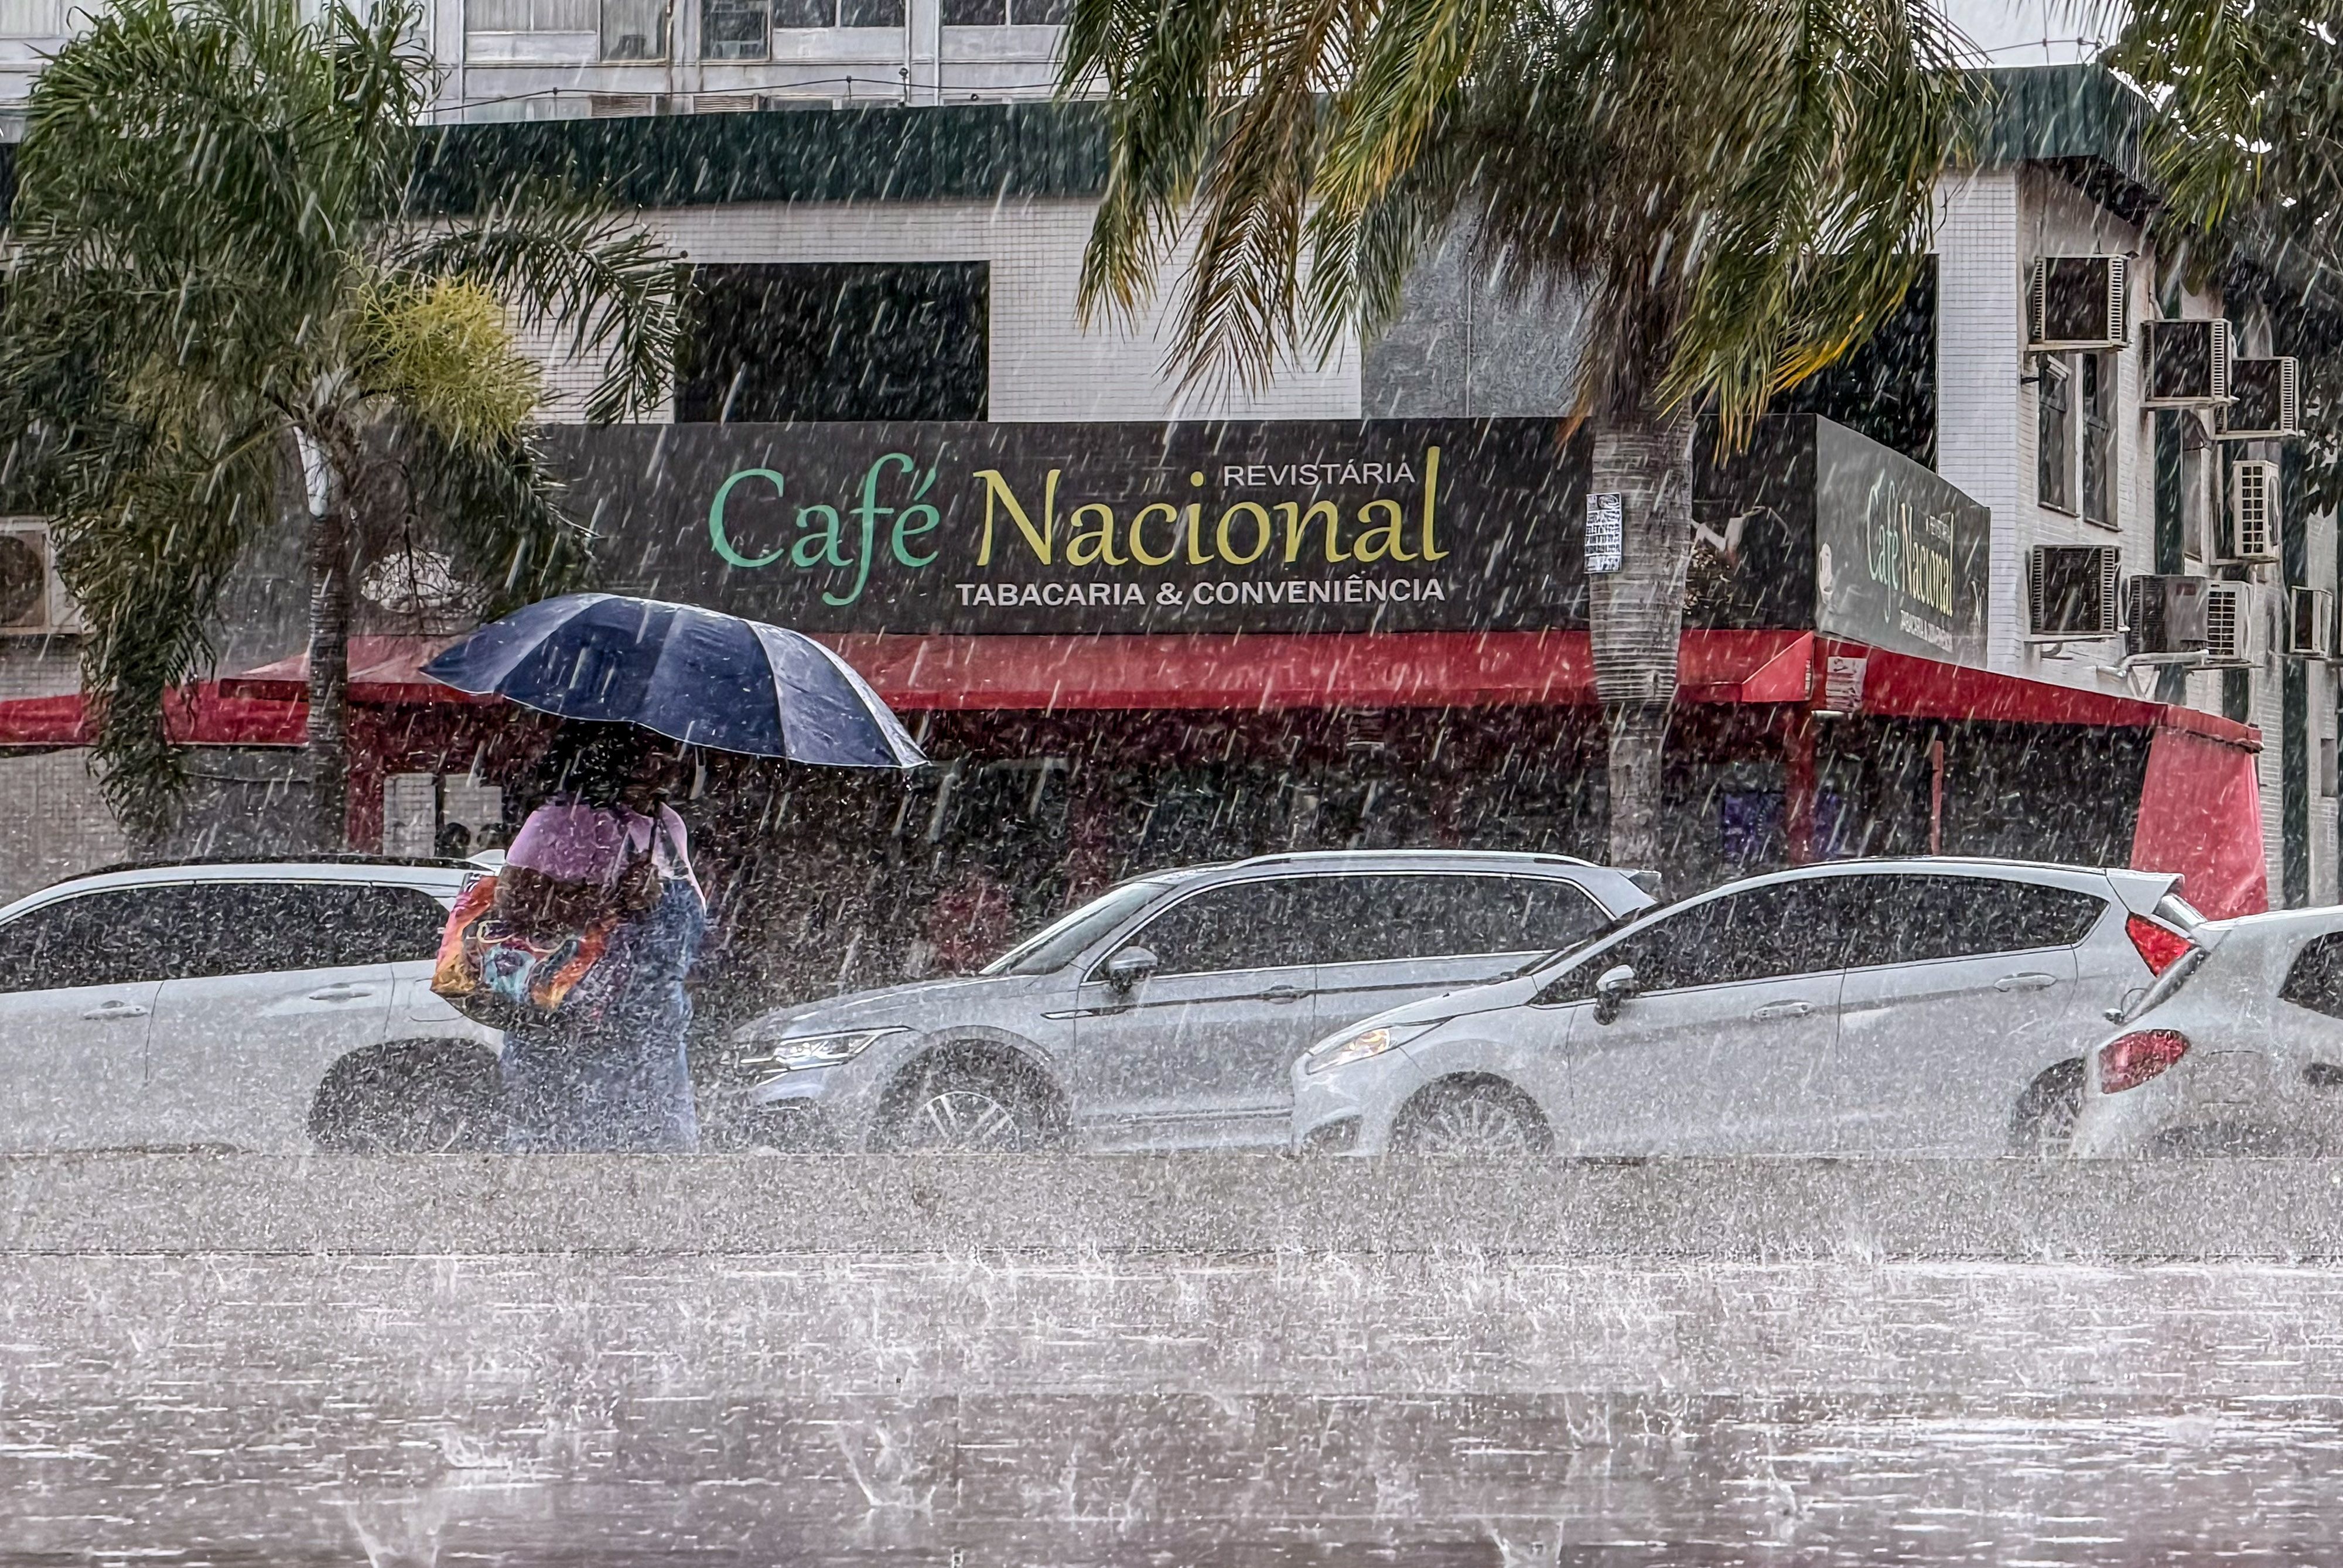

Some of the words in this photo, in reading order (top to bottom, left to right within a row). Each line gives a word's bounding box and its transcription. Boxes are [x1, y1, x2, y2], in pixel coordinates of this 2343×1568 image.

[1225, 459, 1415, 486] REVISTÁRIA
[709, 453, 939, 606] Café
[973, 446, 1449, 565] Nacional
[1901, 503, 1953, 617] Nacional
[956, 582, 1145, 606] TABACARIA
[1156, 582, 1183, 606] &
[1193, 575, 1445, 605] CONVENIÊNCIA
